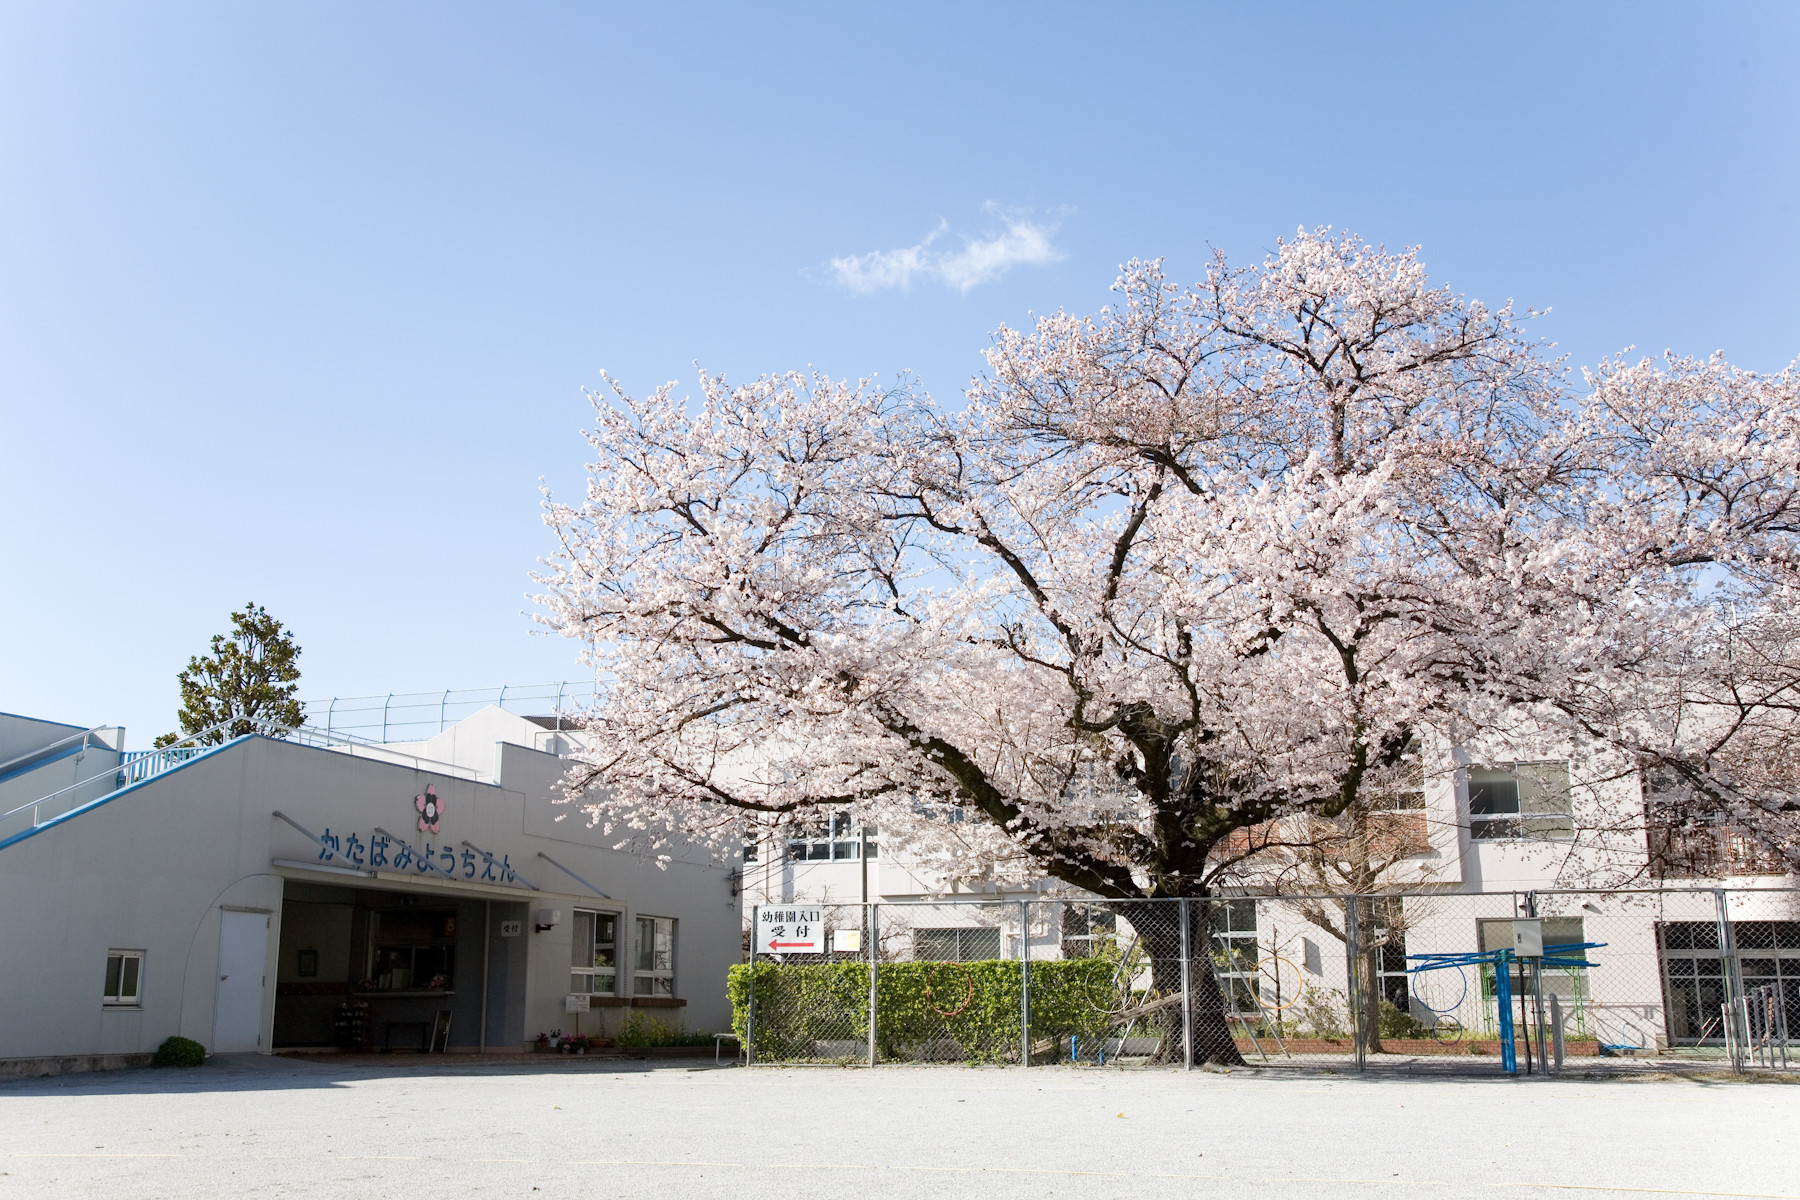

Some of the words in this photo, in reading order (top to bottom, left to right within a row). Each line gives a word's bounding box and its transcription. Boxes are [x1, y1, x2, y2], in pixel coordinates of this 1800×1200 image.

[319, 828, 516, 882] かたばみようちえん
[762, 911, 820, 923] 幼稚園入口
